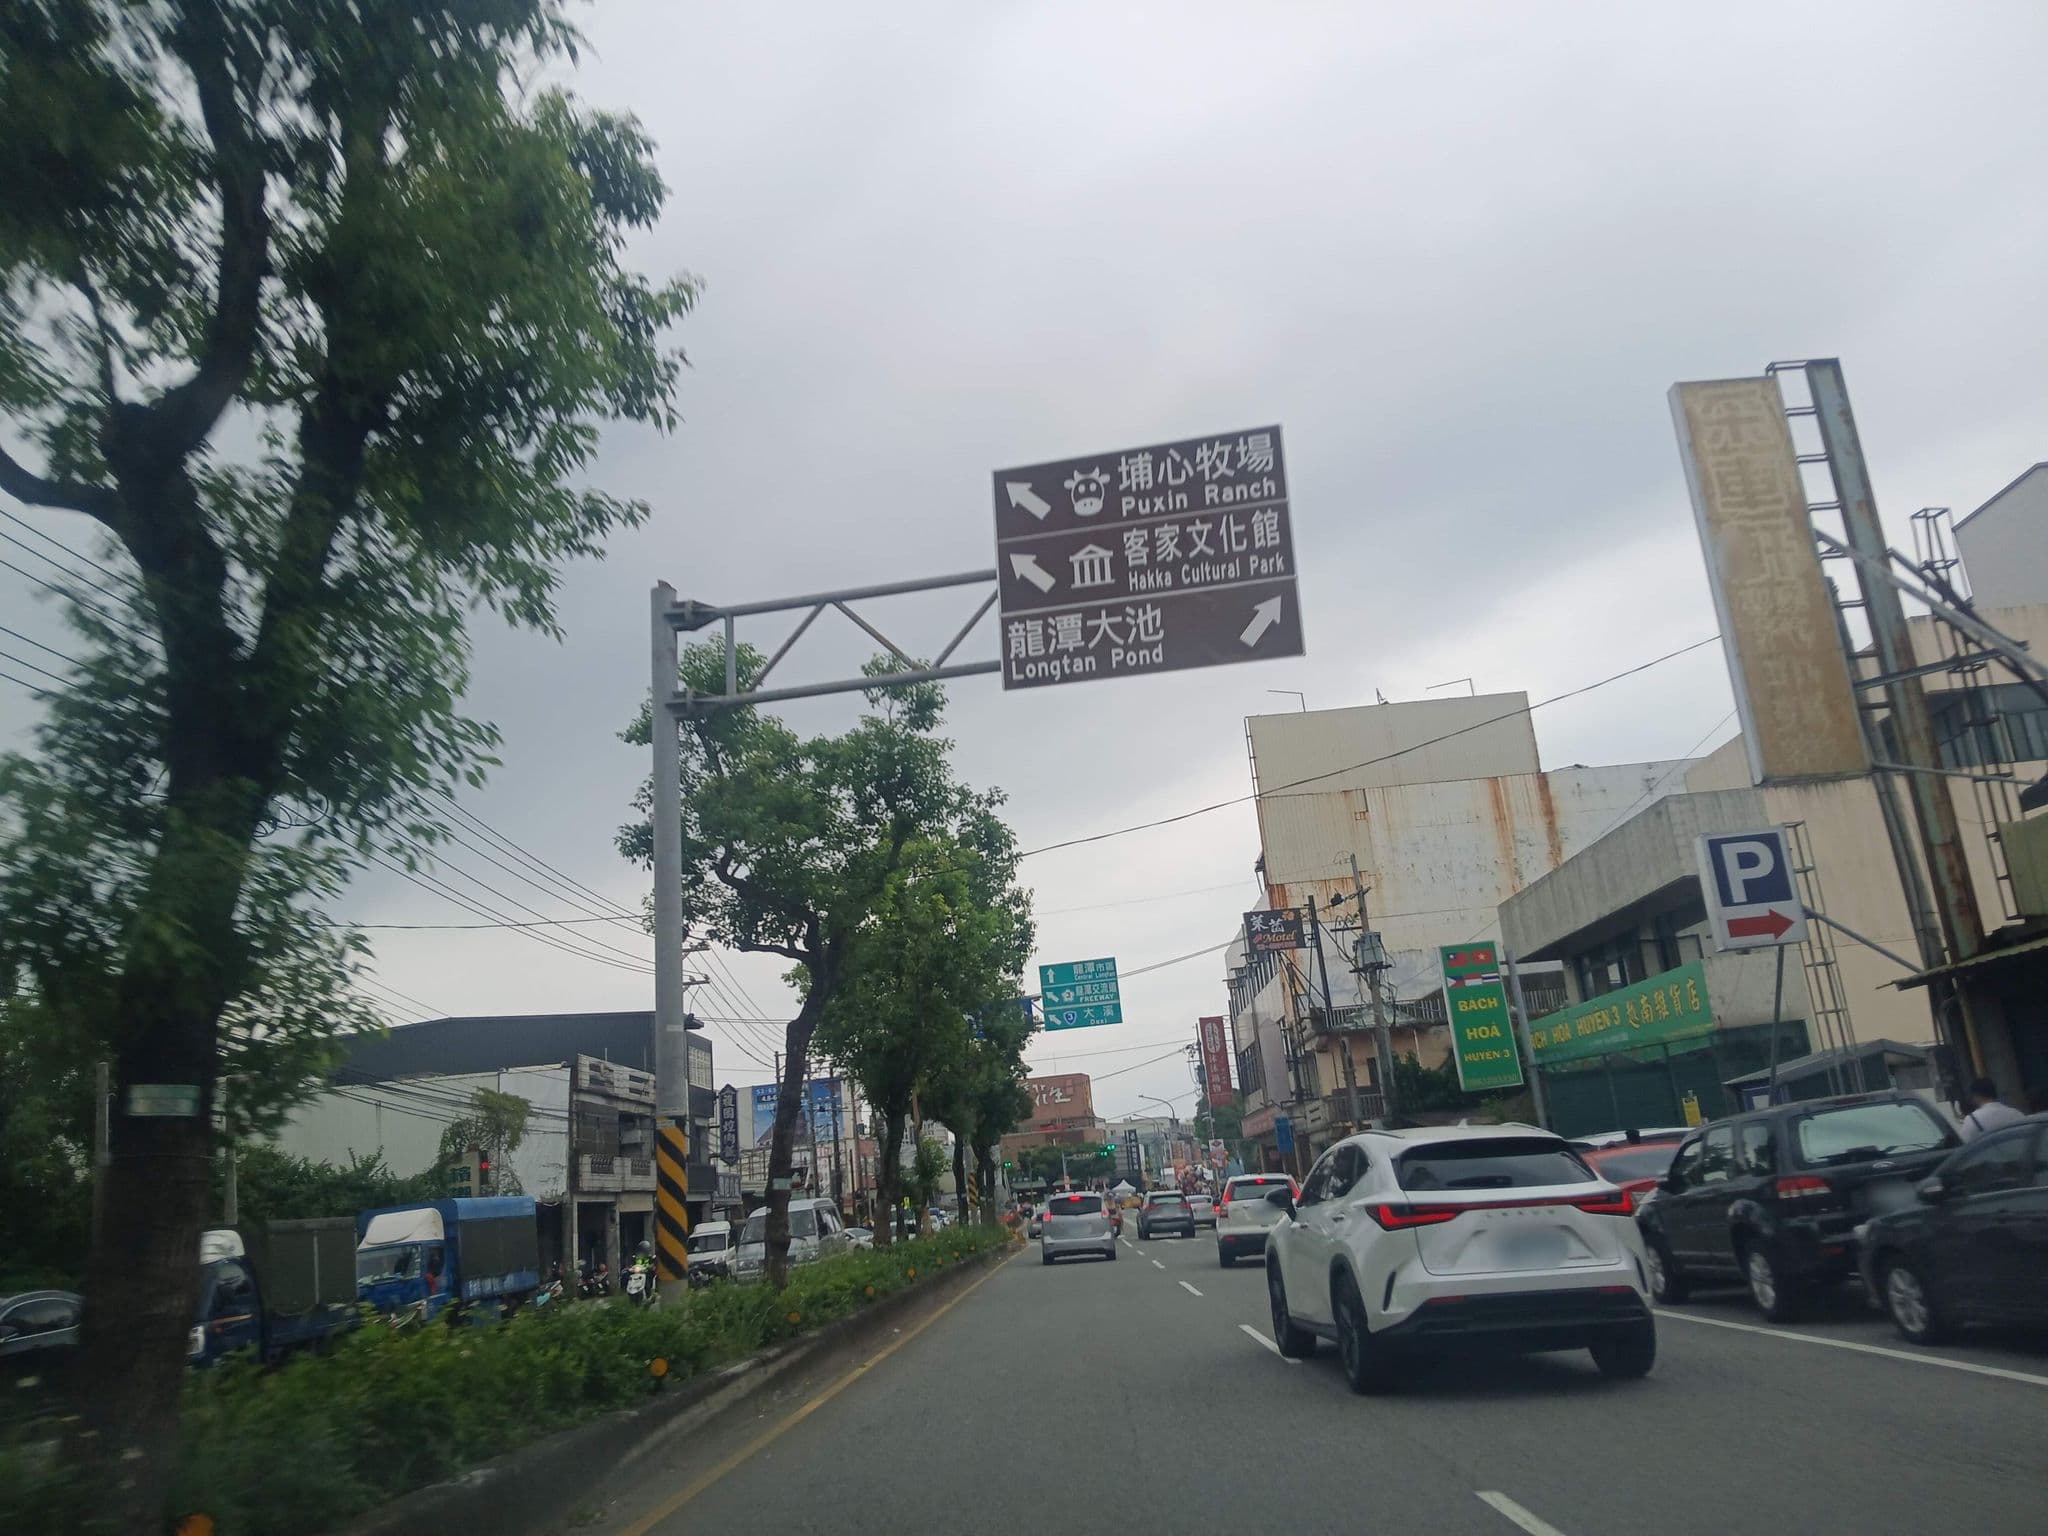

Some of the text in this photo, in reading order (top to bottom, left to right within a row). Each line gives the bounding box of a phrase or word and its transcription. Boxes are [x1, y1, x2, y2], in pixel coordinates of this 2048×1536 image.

[1118, 432, 1274, 492] 埔心牧場
[1121, 476, 1276, 517] Puxin Ranch
[1123, 508, 1280, 567] 客家文化館
[1128, 552, 1285, 592] Hakka Cultural Park
[1008, 603, 1164, 659] 龍潭大池
[1012, 642, 1164, 681] Longtan Pond
[1719, 840, 1775, 904] P
[1262, 930, 1297, 943] Motel
[1067, 1013, 1074, 1021] 3
[1612, 1004, 1621, 1026] 3
[1503, 1049, 1511, 1058] 3
